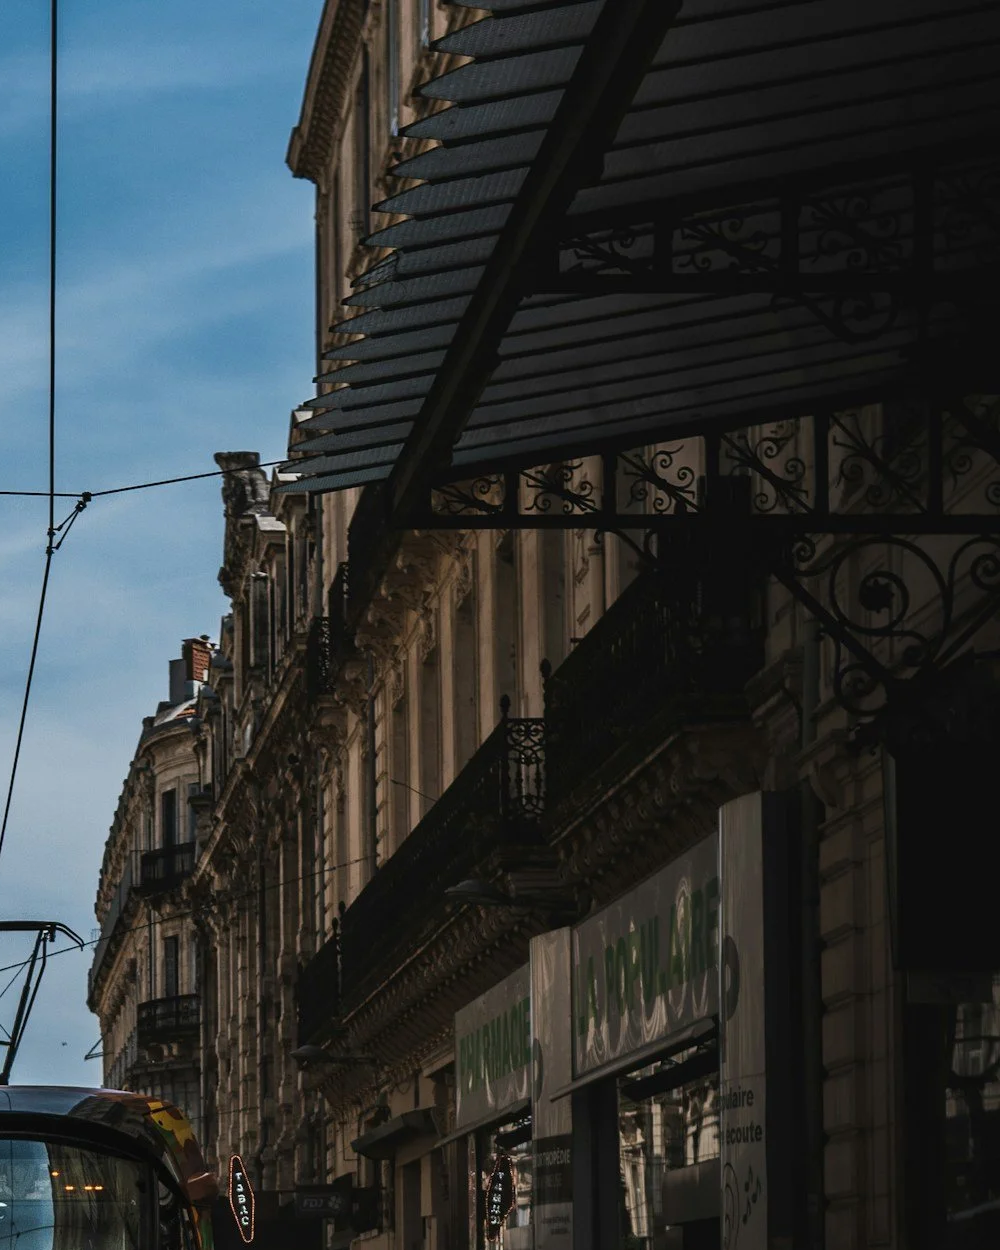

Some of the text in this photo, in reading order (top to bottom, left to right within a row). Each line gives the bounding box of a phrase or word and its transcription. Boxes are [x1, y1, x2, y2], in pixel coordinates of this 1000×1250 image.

[460, 996, 531, 1096] PHARMACIE
[235, 1172, 249, 1225] TABAC
[303, 1198, 324, 1208] FDJ
